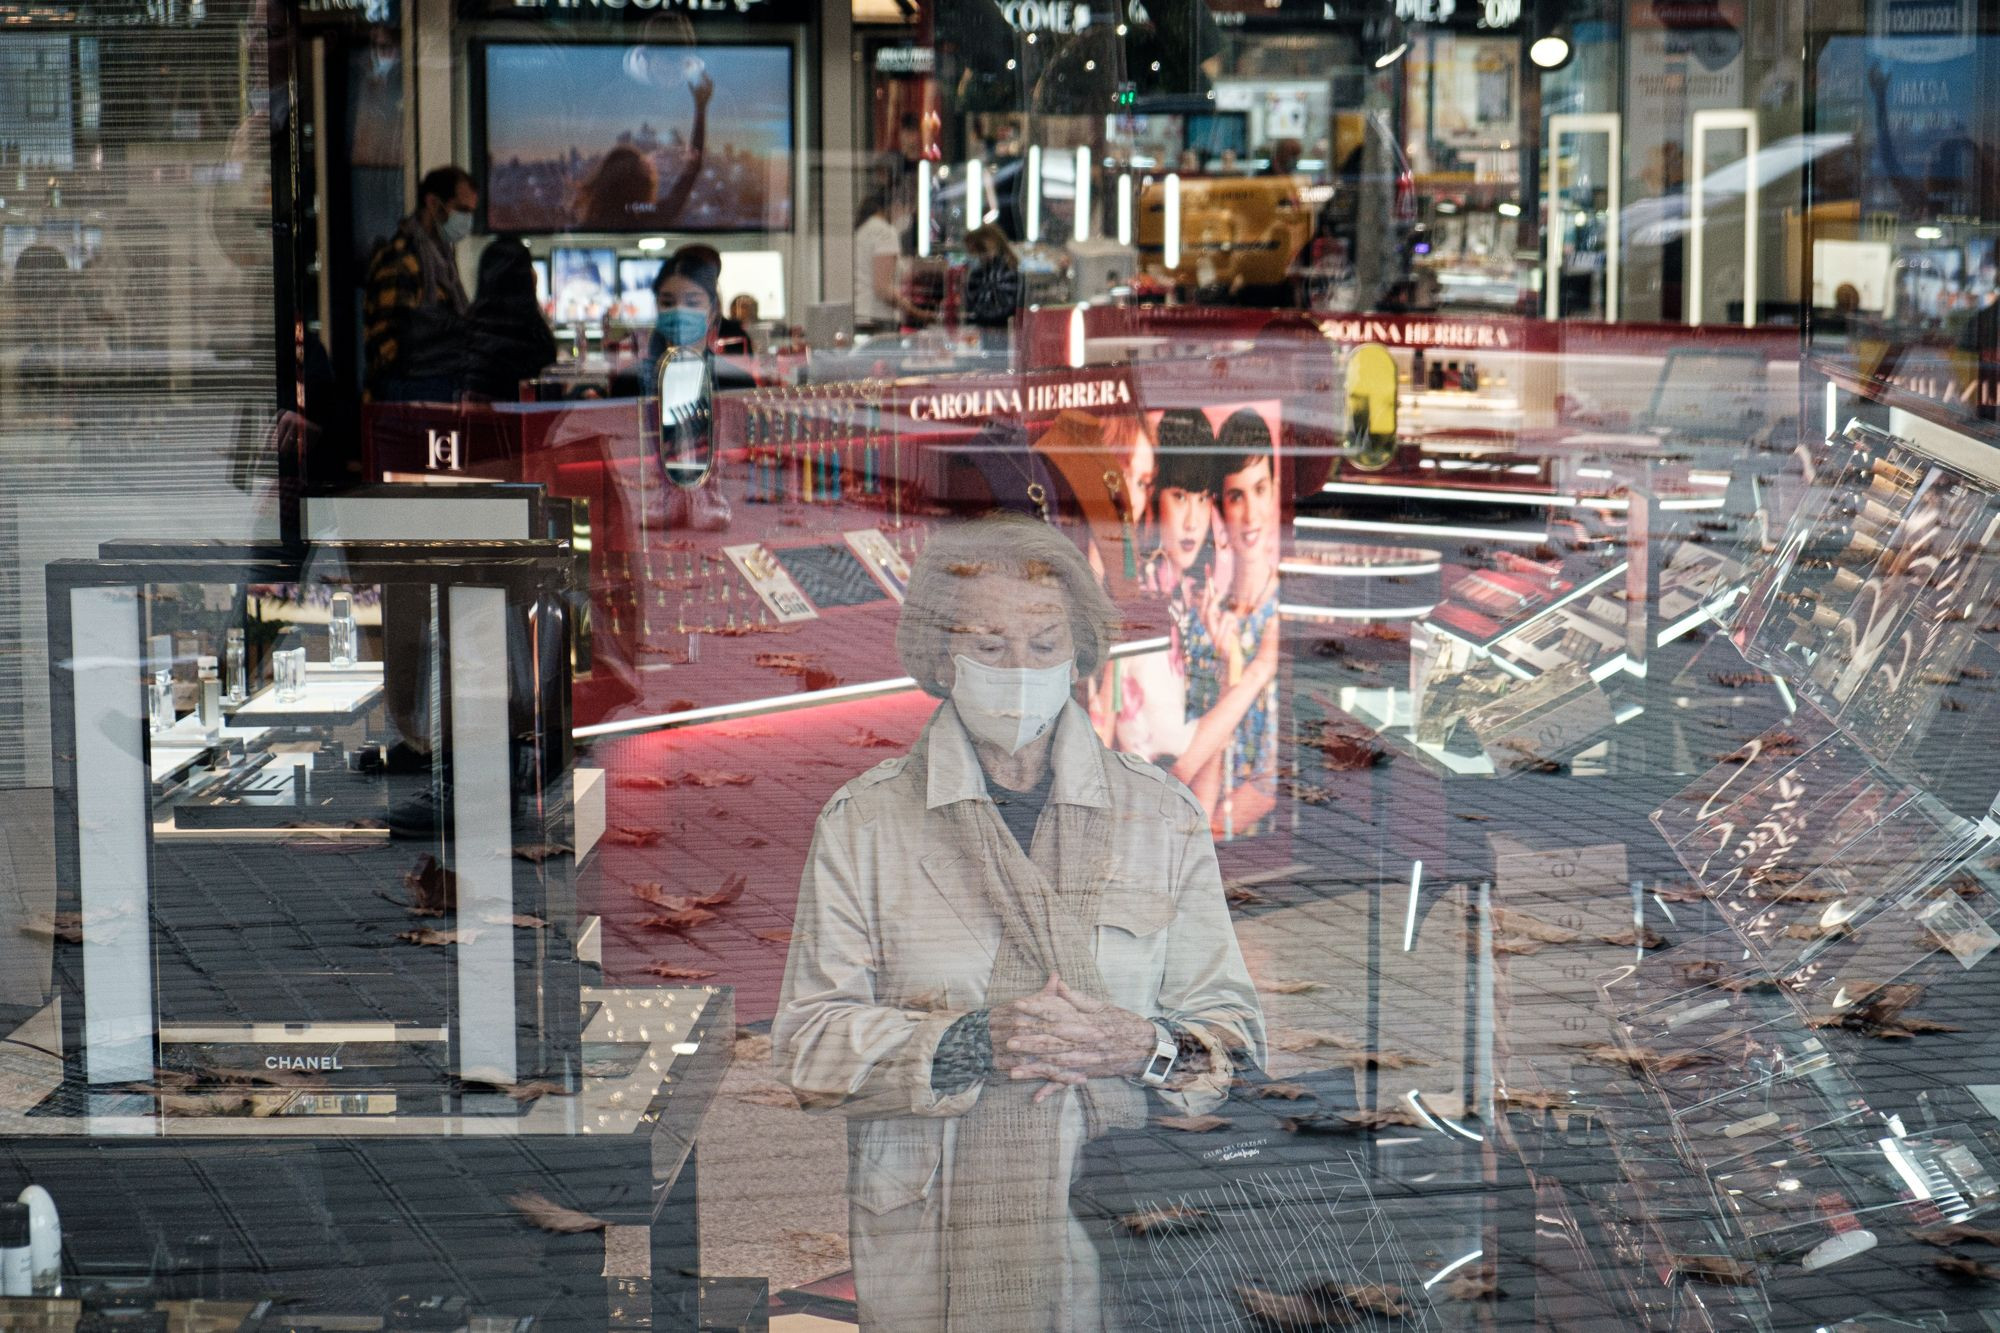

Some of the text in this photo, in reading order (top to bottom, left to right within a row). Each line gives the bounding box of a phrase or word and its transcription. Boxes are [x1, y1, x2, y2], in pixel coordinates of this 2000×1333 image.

[1404, 321, 1509, 347] HERRERA
[909, 379, 1130, 421] CAROLINA HERRERA
[264, 1056, 343, 1070] CHANEL
